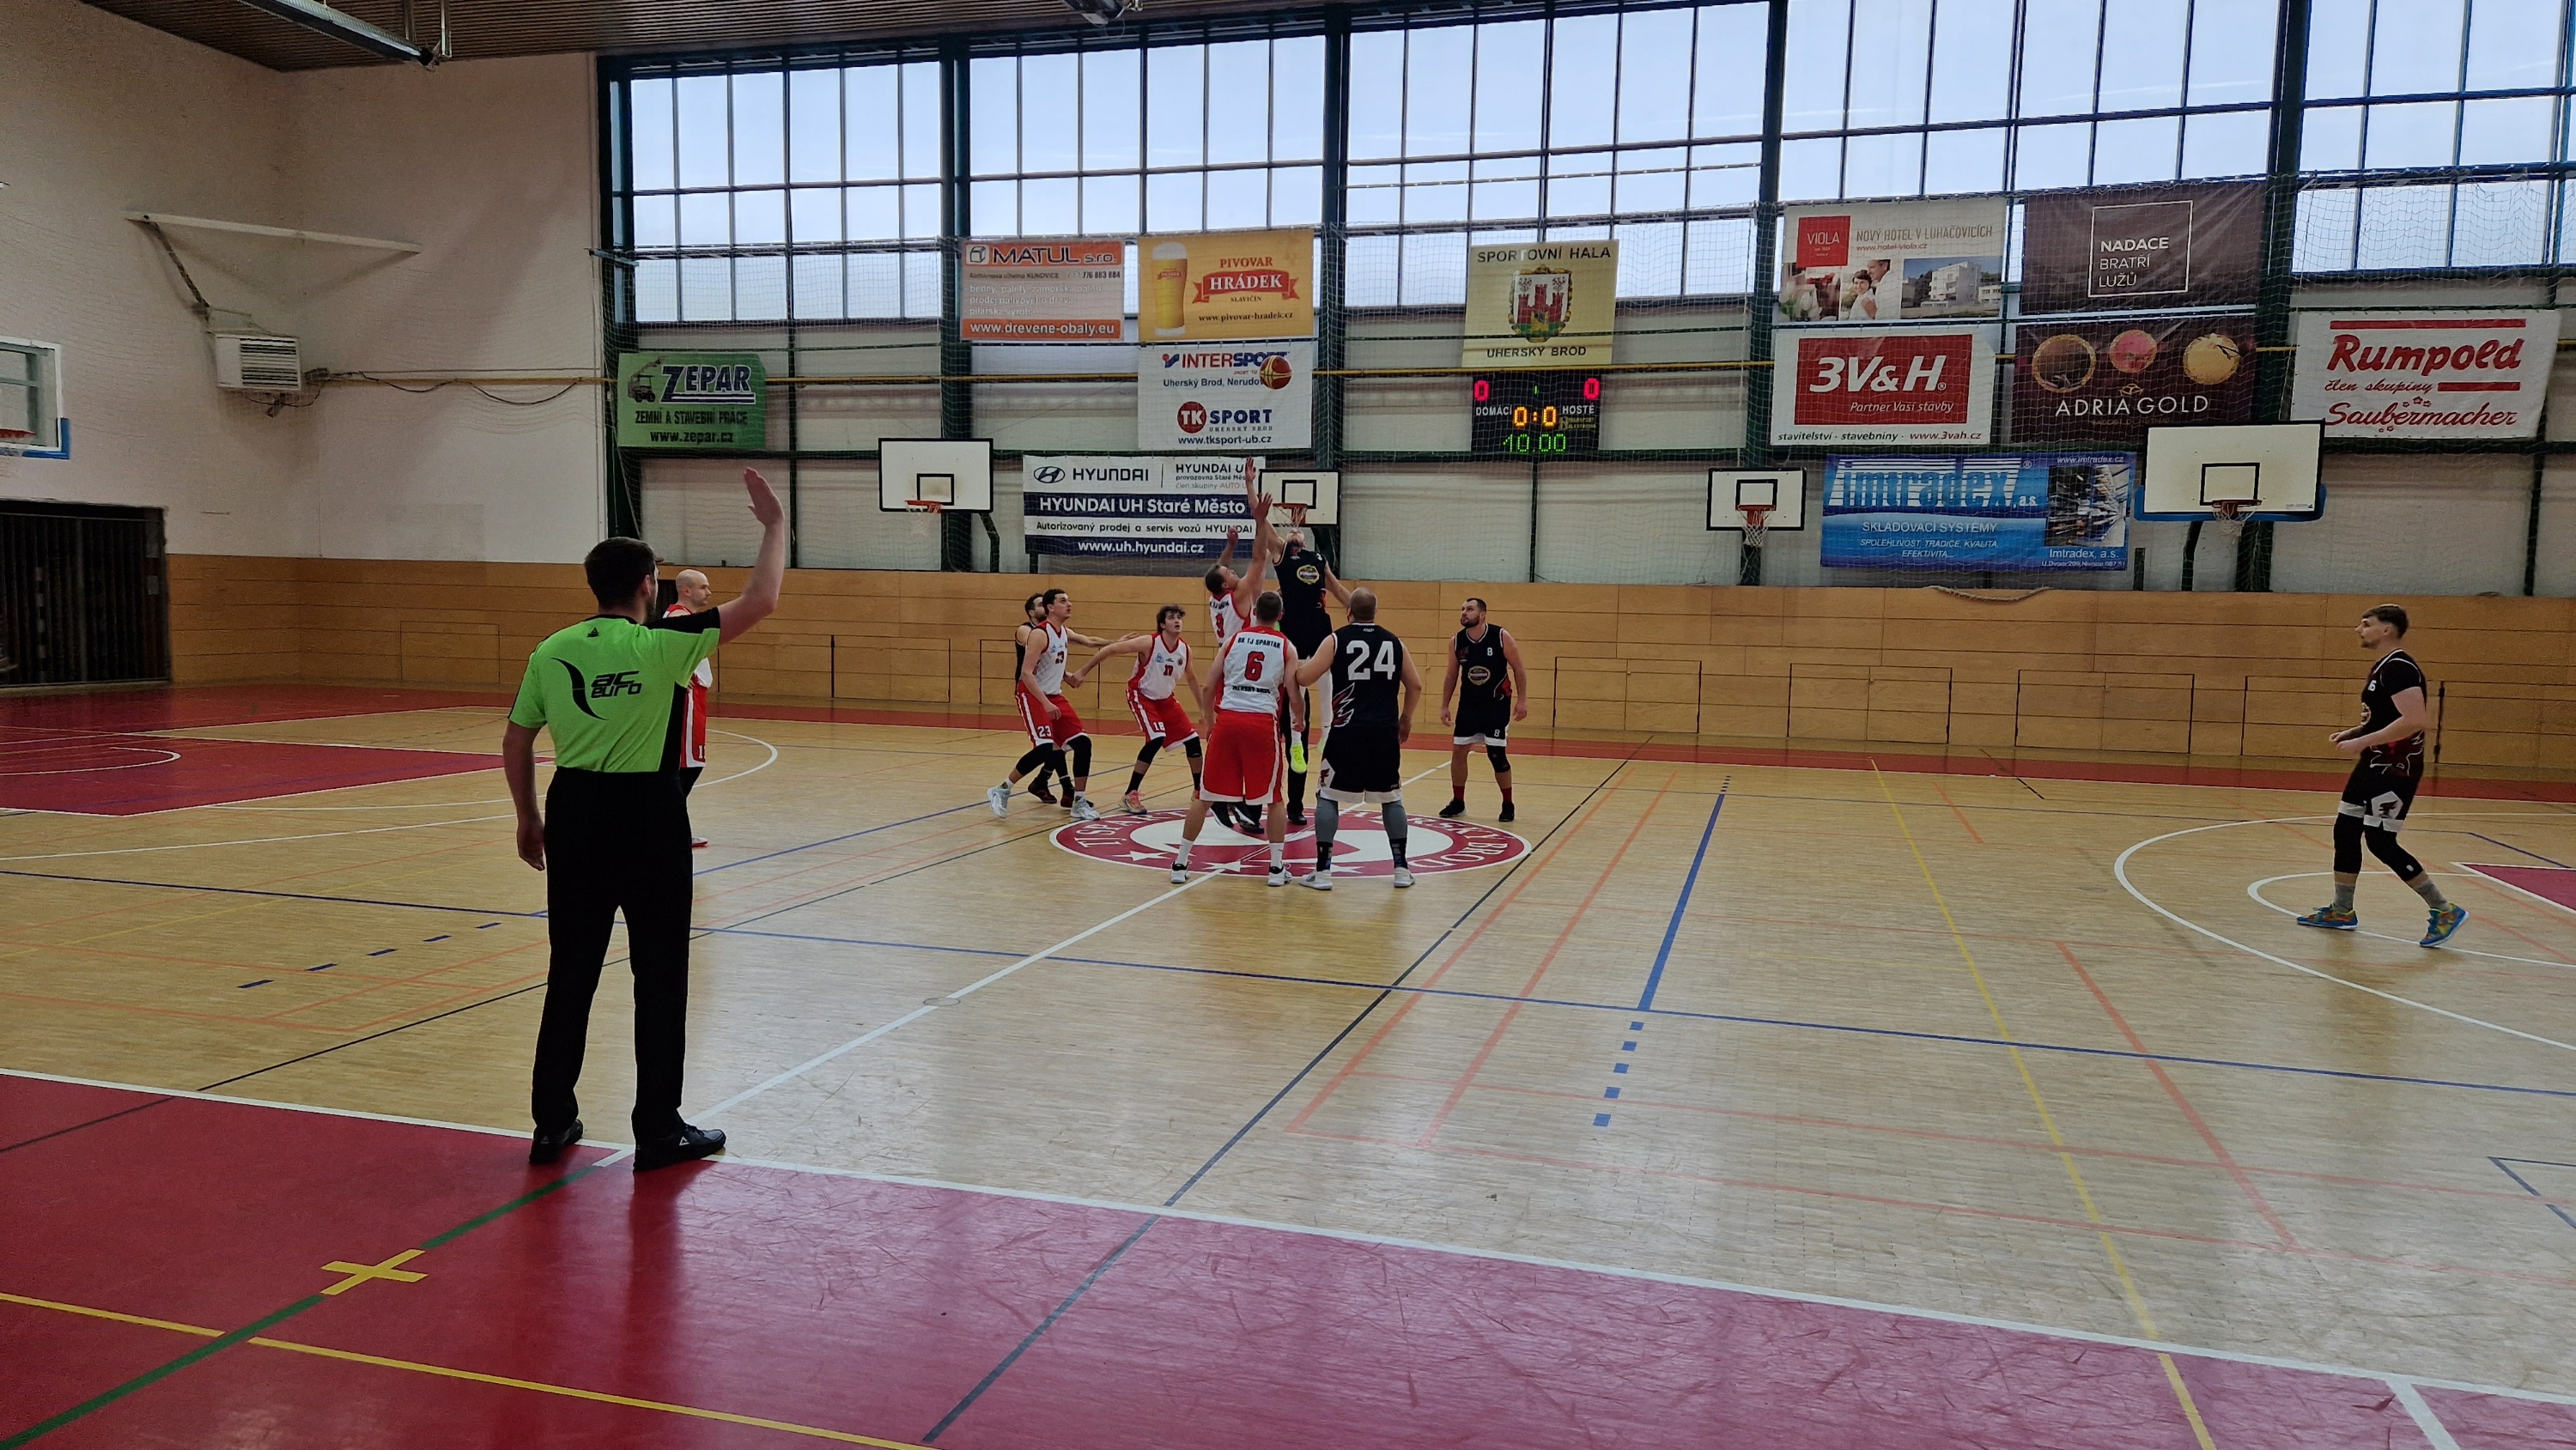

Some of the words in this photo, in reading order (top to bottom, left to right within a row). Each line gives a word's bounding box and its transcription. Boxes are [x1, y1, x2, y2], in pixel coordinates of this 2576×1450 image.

[1807, 231, 1840, 245] VIOLA
[1856, 228, 1881, 241] NOVÝ
[1885, 228, 1912, 240] HOTEL
[1916, 228, 1923, 240] V
[1856, 243, 1928, 252] www.hotel-viola.cz
[2100, 236, 2170, 252] NADACE
[993, 246, 1079, 264] MATUL
[1084, 254, 1116, 263] s.r.o.
[1477, 246, 1563, 263] SPORTOVNÍ
[1570, 246, 1611, 259] HALA
[2099, 253, 2150, 270] BRATŘÍ
[1219, 256, 1273, 269] PIVOVAR
[1209, 273, 1283, 290] HRÁDEK
[2099, 270, 2137, 288] LUŽŮ
[1199, 312, 1293, 323] www.pivovar-hradek.cz
[970, 321, 1115, 337] www.drevene-obaly.eu
[1551, 345, 1587, 357] BROD
[2326, 333, 2525, 376] Rumpold
[1182, 351, 1290, 368] INTERSPO
[660, 364, 752, 404] ZEPAR
[1163, 378, 1199, 388] Uherský
[1201, 379, 1224, 387] Brod,
[1474, 380, 1489, 402] 0
[1584, 378, 1601, 400] 0
[2324, 379, 2359, 392] člen
[2364, 378, 2433, 395] skupiny
[1476, 404, 1512, 416] DOMÁCÍ
[1850, 402, 1891, 412] Partner
[1917, 401, 1954, 414] stavby
[2324, 401, 2518, 427] Saubermacher
[665, 411, 671, 424] A
[1181, 410, 1203, 425] TK
[1209, 409, 1273, 424] SPORT
[650, 431, 733, 445] www.zepar.cz
[1178, 434, 1272, 446] www.tksport-ub.cz
[1778, 431, 1833, 441] stavitelství
[1841, 431, 1899, 441] stavebniny
[1910, 431, 1983, 440] www.3vah.cz
[1072, 468, 1149, 482] HYUNDAI
[1176, 464, 1231, 473] HYUNDAI
[1040, 497, 1115, 513] HYUNDAI
[1119, 498, 1142, 513] UH
[1147, 498, 1190, 513] Staré
[1195, 498, 1246, 514] Město
[1036, 521, 1096, 532] Autorizovaný
[1099, 523, 1130, 534] prodej
[1178, 524, 1201, 533] vozů
[1078, 541, 1205, 555] www.uh.hyundai.cz
[2049, 548, 2097, 559] Imtradex,
[1216, 614, 1224, 639] 9
[1255, 639, 1281, 649] SPARTAK
[1487, 647, 1493, 656] 8
[1244, 651, 1266, 682] 6
[1346, 640, 1396, 681] 24
[591, 683, 642, 699] euro
[1037, 725, 1052, 737] 23
[1153, 721, 1165, 731] 18
